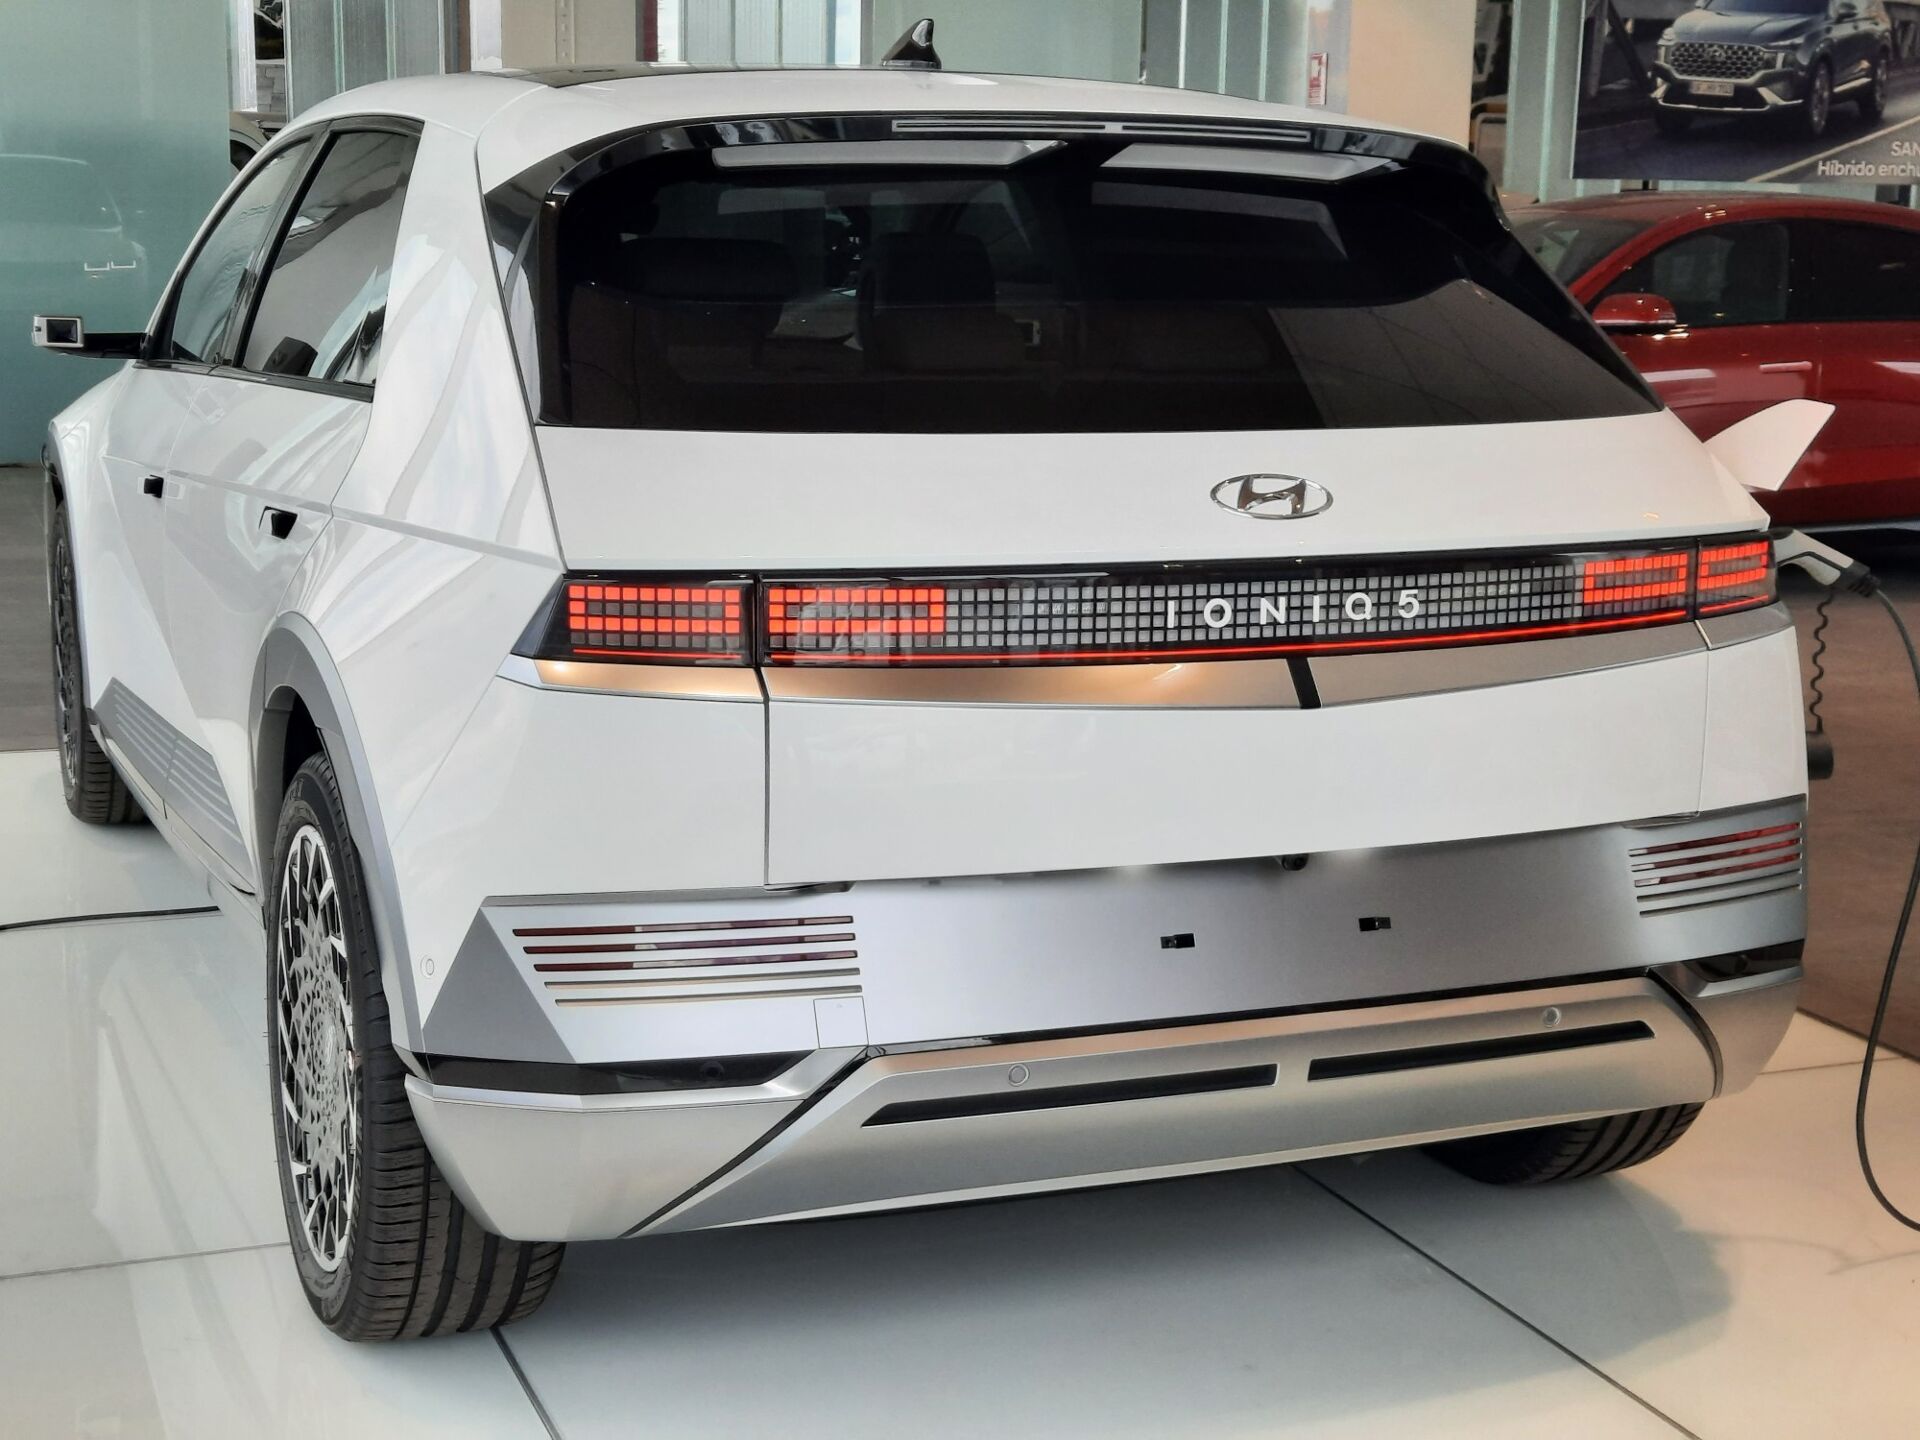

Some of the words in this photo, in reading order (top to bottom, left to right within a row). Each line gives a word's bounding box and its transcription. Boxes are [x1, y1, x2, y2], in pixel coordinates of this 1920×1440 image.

[1817, 160, 1876, 176] Híbrido
[1166, 592, 1373, 629] IONIQ
[1398, 589, 1420, 618] 5
